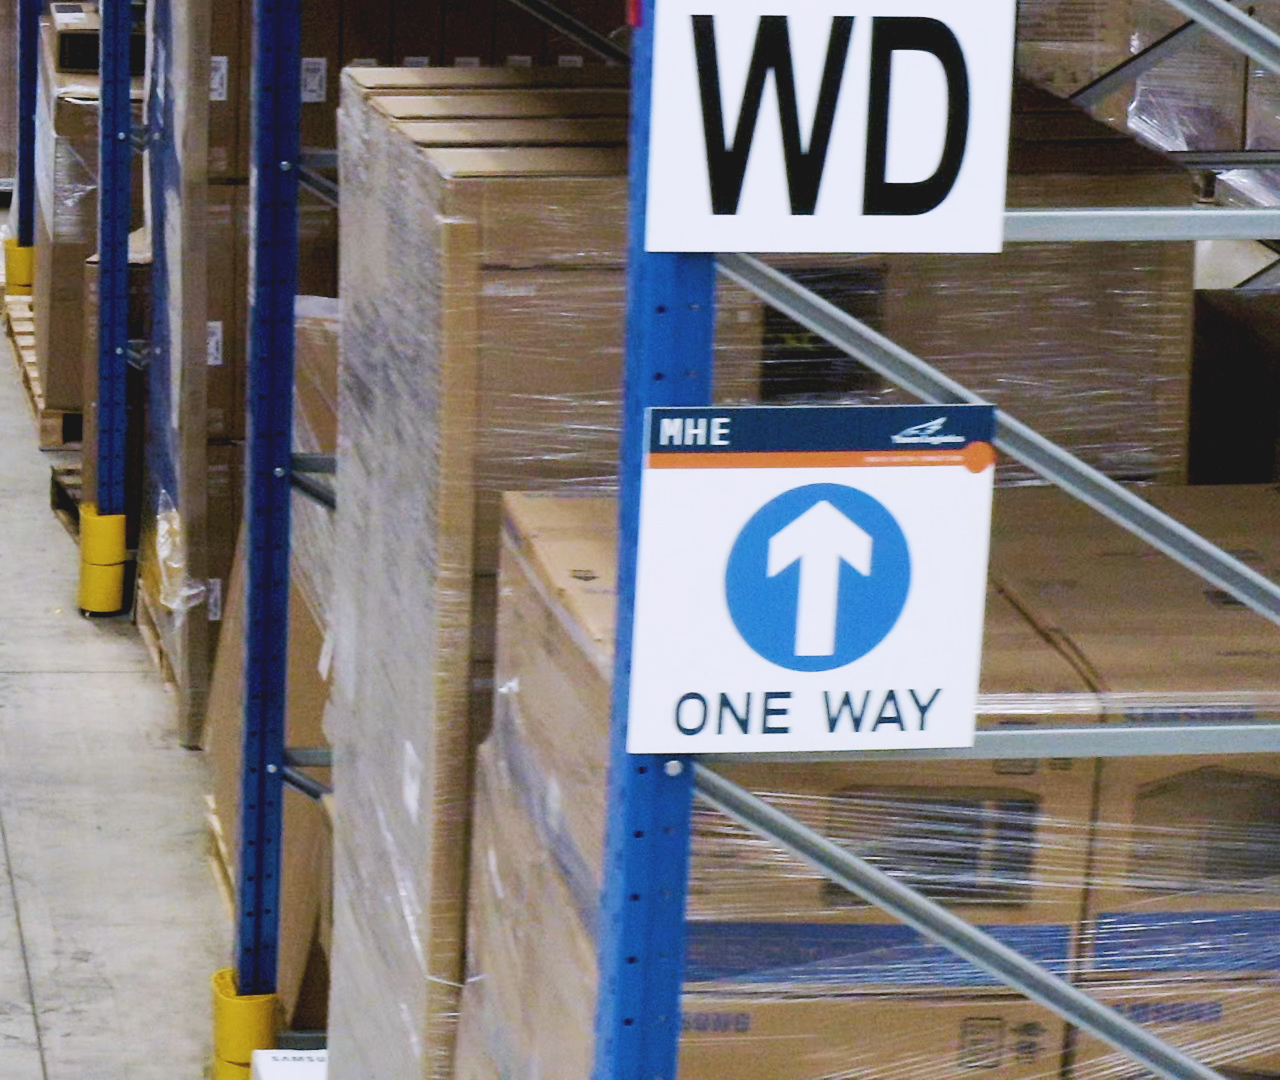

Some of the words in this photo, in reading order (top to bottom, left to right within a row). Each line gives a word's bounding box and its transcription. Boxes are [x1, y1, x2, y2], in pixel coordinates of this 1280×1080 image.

[690, 14, 970, 216] WD
[658, 417, 732, 446] MHE
[675, 690, 792, 736] ONE
[823, 687, 942, 734] WAY
